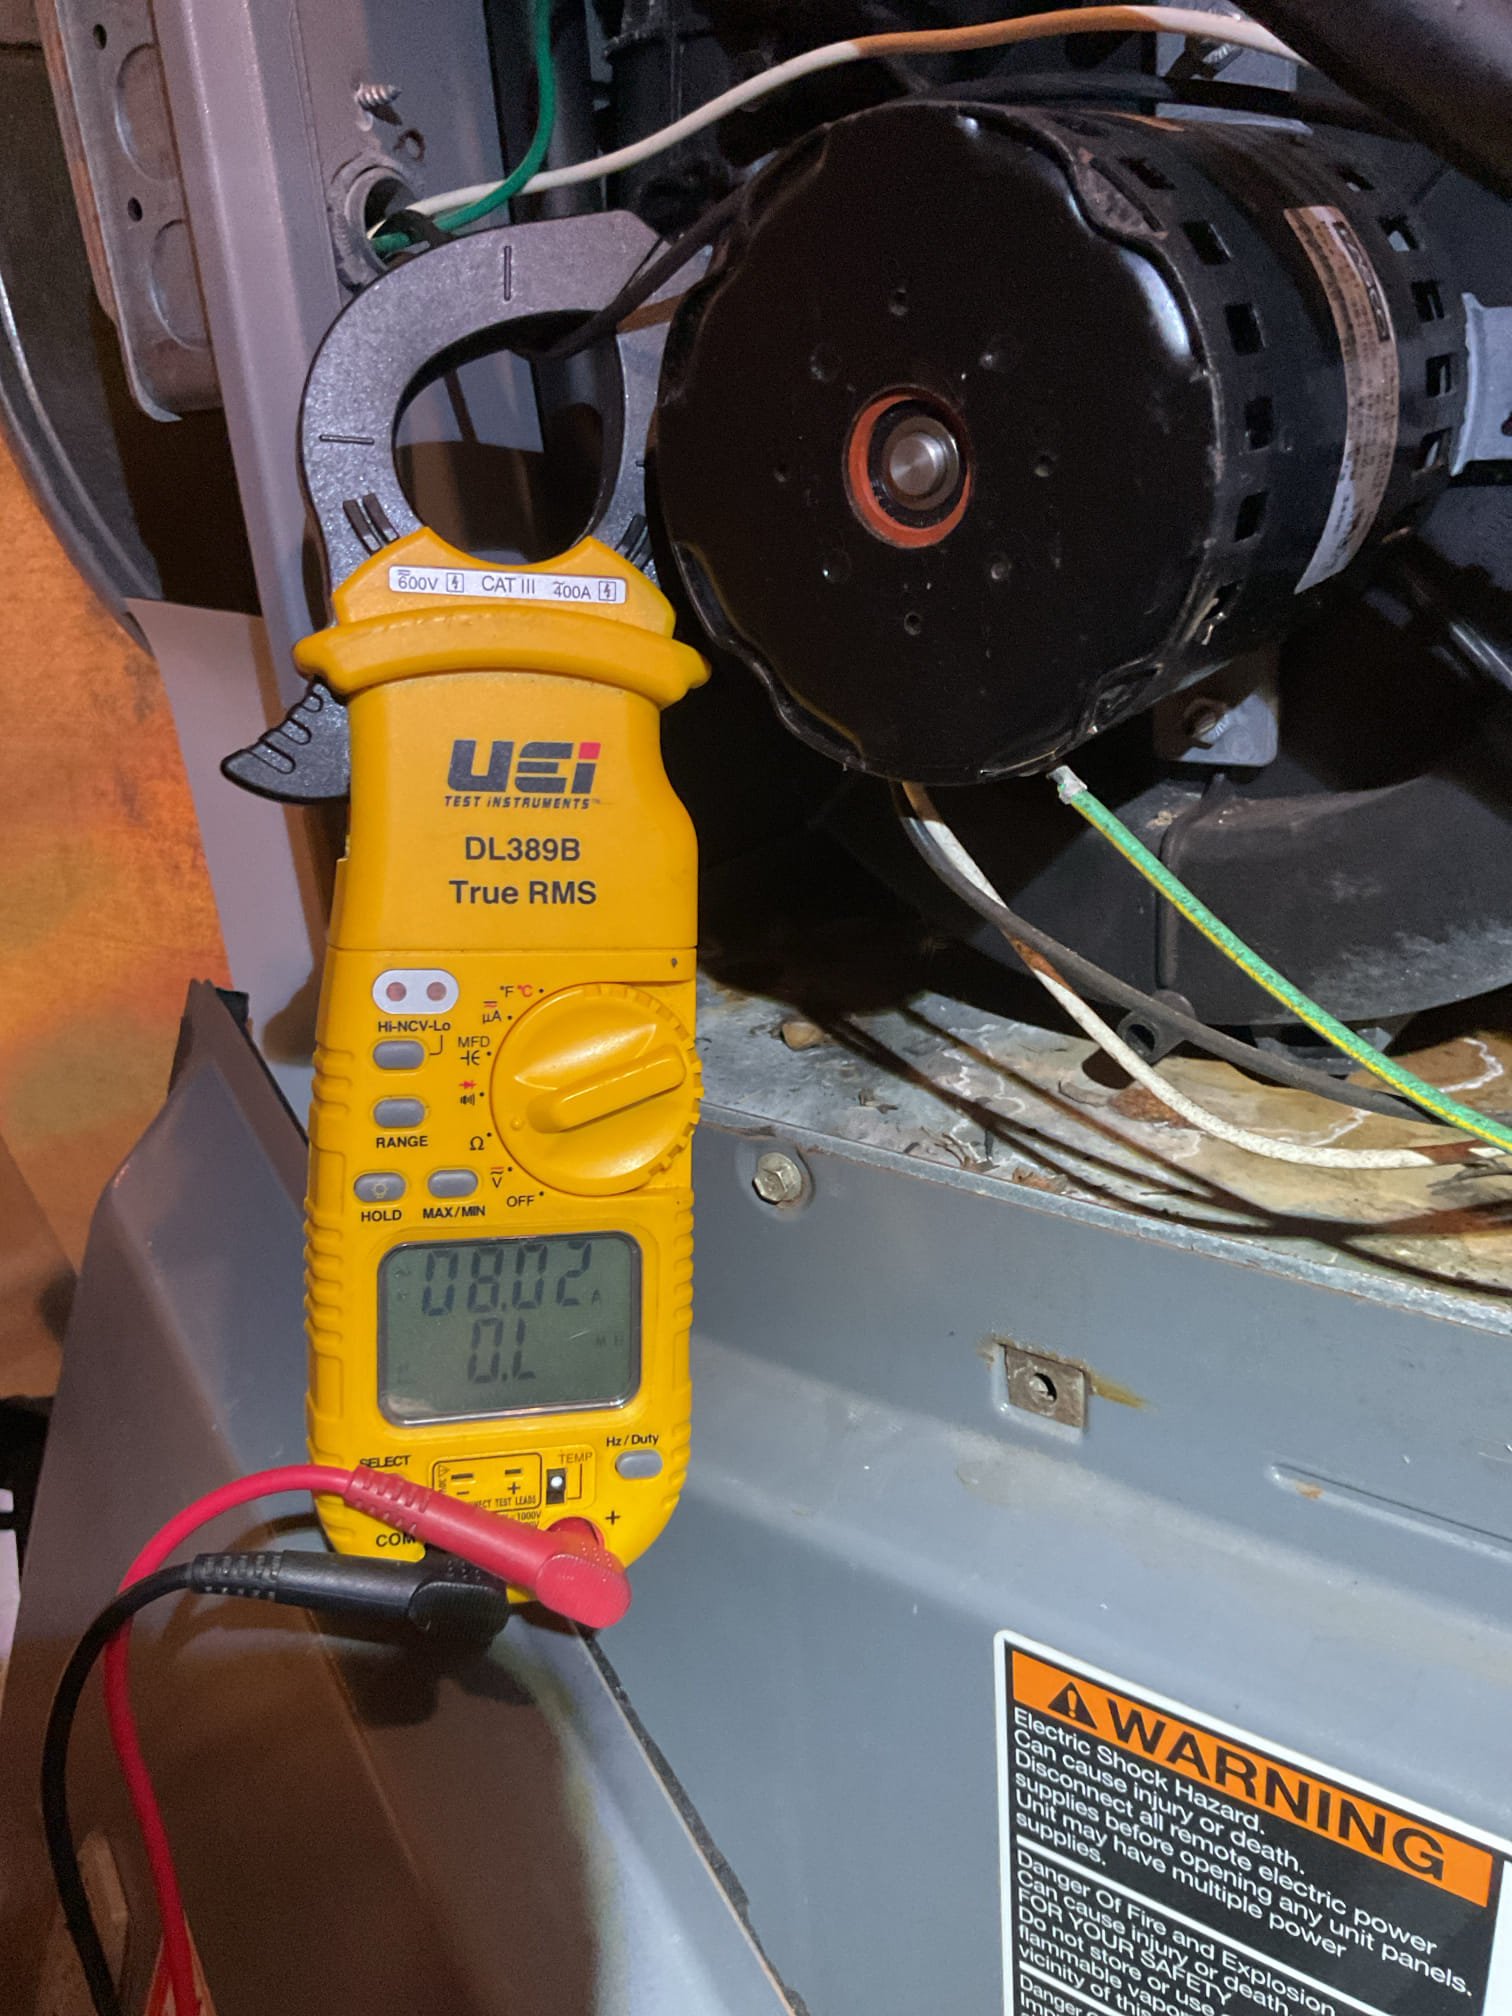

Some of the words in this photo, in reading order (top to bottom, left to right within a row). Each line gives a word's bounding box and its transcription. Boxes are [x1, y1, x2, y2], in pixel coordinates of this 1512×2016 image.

[398, 575, 439, 591] 600V
[481, 576, 516, 593] CAT
[521, 578, 536, 594] III
[553, 582, 592, 599] 400A
[445, 796, 481, 807] TEST
[465, 836, 581, 862] DL389B
[449, 880, 519, 904] True
[529, 881, 597, 905] RMS
[378, 1020, 451, 1032] Hi-NCV-Lo
[458, 1035, 490, 1047] MFD
[376, 1136, 428, 1149] RANGE
[361, 1209, 402, 1221] HOLD
[506, 1195, 535, 1207] OFF
[360, 1454, 412, 1468] SELECT
[559, 1452, 593, 1465] TEMP
[495, 1497, 512, 1507] TEST
[375, 1532, 416, 1547] COM
[1014, 1706, 1091, 1755] Electric
[1097, 1745, 1168, 1791] Shock
[1176, 1779, 1265, 1835] Hazard.
[1107, 1697, 1445, 1881] WARNING
[1014, 1729, 1056, 1761] Can
[1062, 1755, 1127, 1792] cause
[1133, 1782, 1193, 1825] injury
[1200, 1817, 1224, 1836] or
[1230, 1830, 1305, 1875] death.
[1016, 1812, 1107, 1867] supplies.
[1016, 1748, 1133, 1817] Disconnect
[1139, 1811, 1163, 1831] all
[1170, 1823, 1251, 1871] remote
[1259, 1865, 1346, 1914] electric
[1354, 1908, 1437, 1955] power
[1016, 1789, 1056, 1822] Unit
[1063, 1814, 1108, 1848] may
[1114, 1835, 1166, 1873] have
[1172, 1866, 1263, 1919] multiple
[1269, 1912, 1347, 1958] power
[1016, 1772, 1099, 1822] supplies
[1106, 1811, 1174, 1856] before
[1180, 1850, 1272, 1906] opening
[1279, 1896, 1323, 1928] any
[1330, 1918, 1375, 1951] unit
[1381, 1943, 1473, 1997] panels.
[1017, 1849, 1091, 1898] Danger
[1096, 1890, 1122, 1914] Of
[1128, 1903, 1166, 1936] Fire
[1172, 1930, 1215, 1960] and
[1222, 1951, 1335, 2016] Explosion
[1017, 1870, 1057, 1902] Can
[1064, 1896, 1126, 1935] cause
[1131, 1925, 1189, 1967] injury
[1194, 1961, 1219, 1980] or
[1223, 1976, 1292, 2016] death
[1018, 1887, 1062, 1923] FOR
[1068, 1911, 1134, 1960] YOUR
[1140, 1949, 1232, 2006] SAFETY
[1019, 1924, 1122, 1990] flammable
[1019, 1905, 1047, 1931] Do
[1052, 1926, 1084, 1952] not
[1090, 1946, 1142, 1981] store
[1147, 1976, 1170, 1994] or
[1176, 1989, 1215, 2016] use
[1019, 1944, 1085, 1989] vicinity
[1090, 1983, 1111, 2002] of
